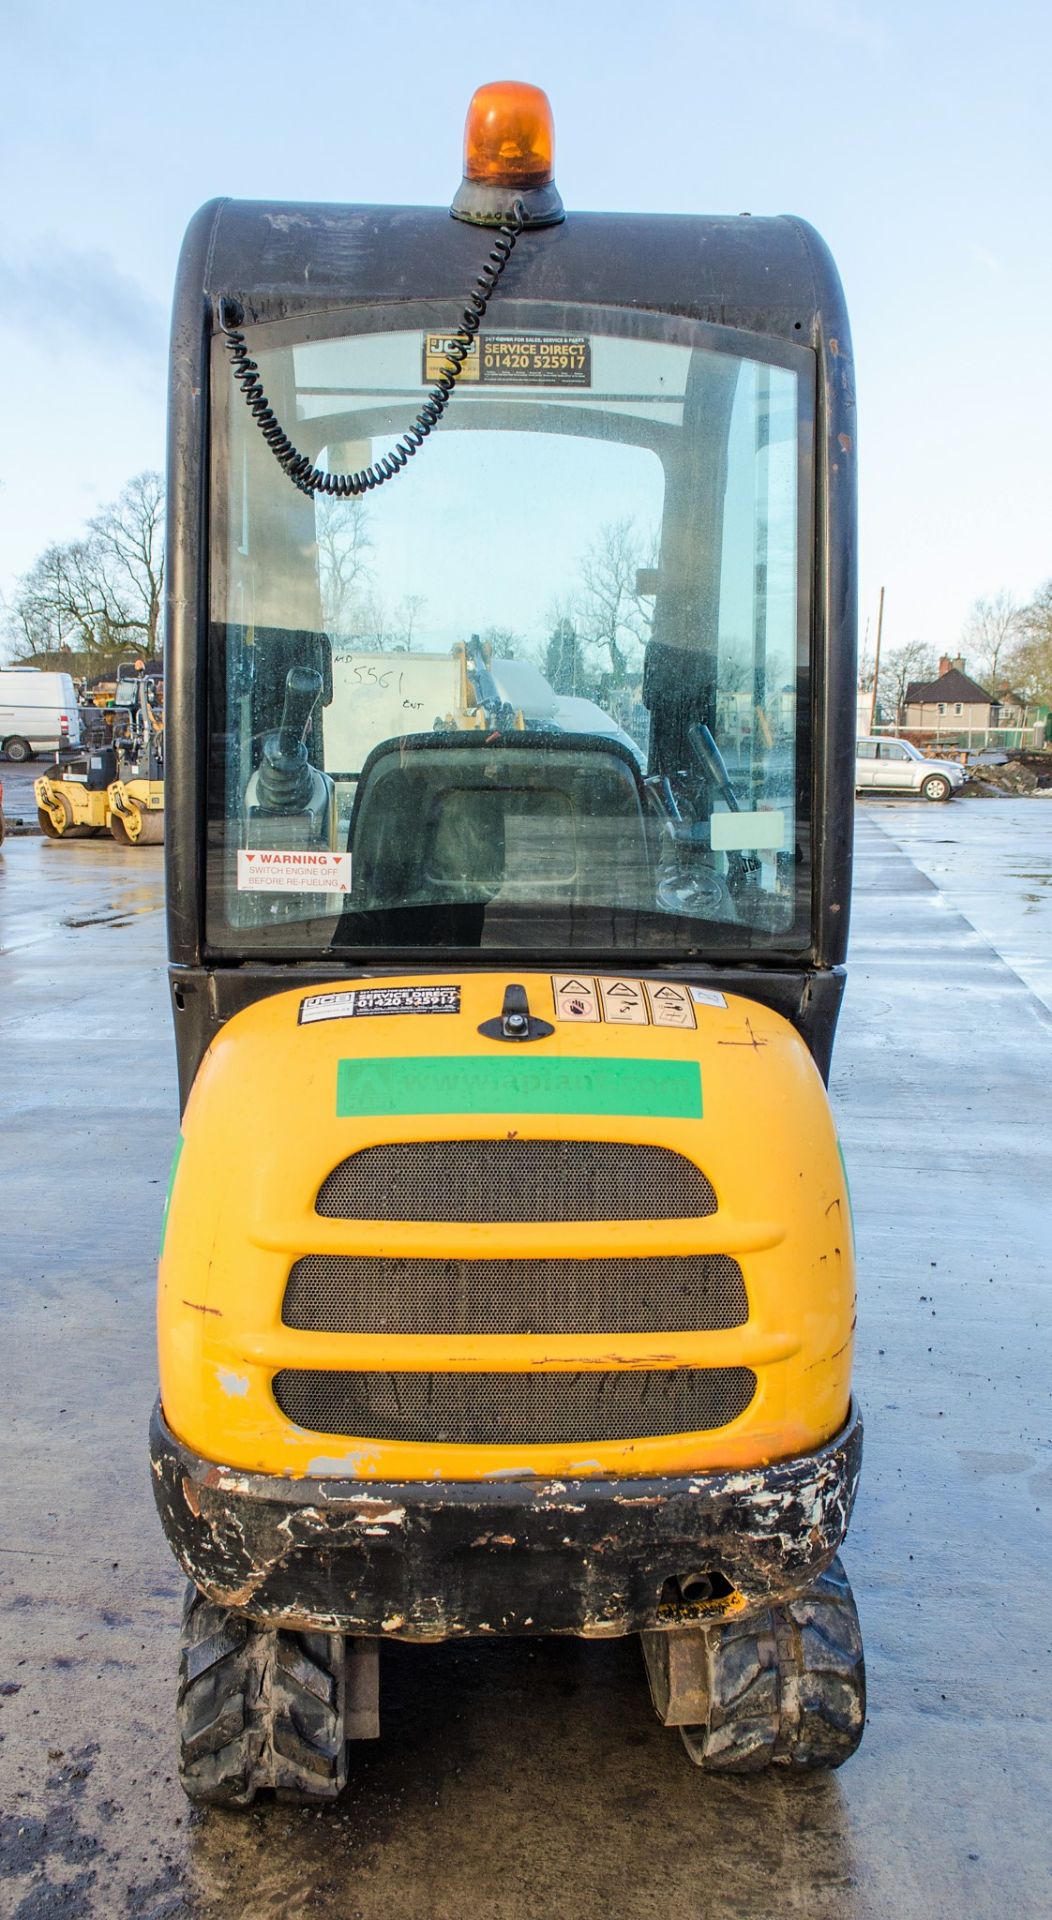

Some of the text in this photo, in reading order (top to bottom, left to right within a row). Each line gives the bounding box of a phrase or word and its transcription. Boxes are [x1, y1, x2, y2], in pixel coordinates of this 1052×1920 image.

[484, 343, 586, 355] SERVICE DIRECT
[484, 354, 586, 369] 01420 525917
[260, 854, 328, 865] WARNING
[249, 866, 339, 876] SWITCH ENGINE OFF
[248, 876, 339, 888] BEFORE RE-FUELING
[358, 991, 410, 1000] SERVICE
[411, 990, 456, 998] DIRECT
[357, 998, 401, 1008] 01420
